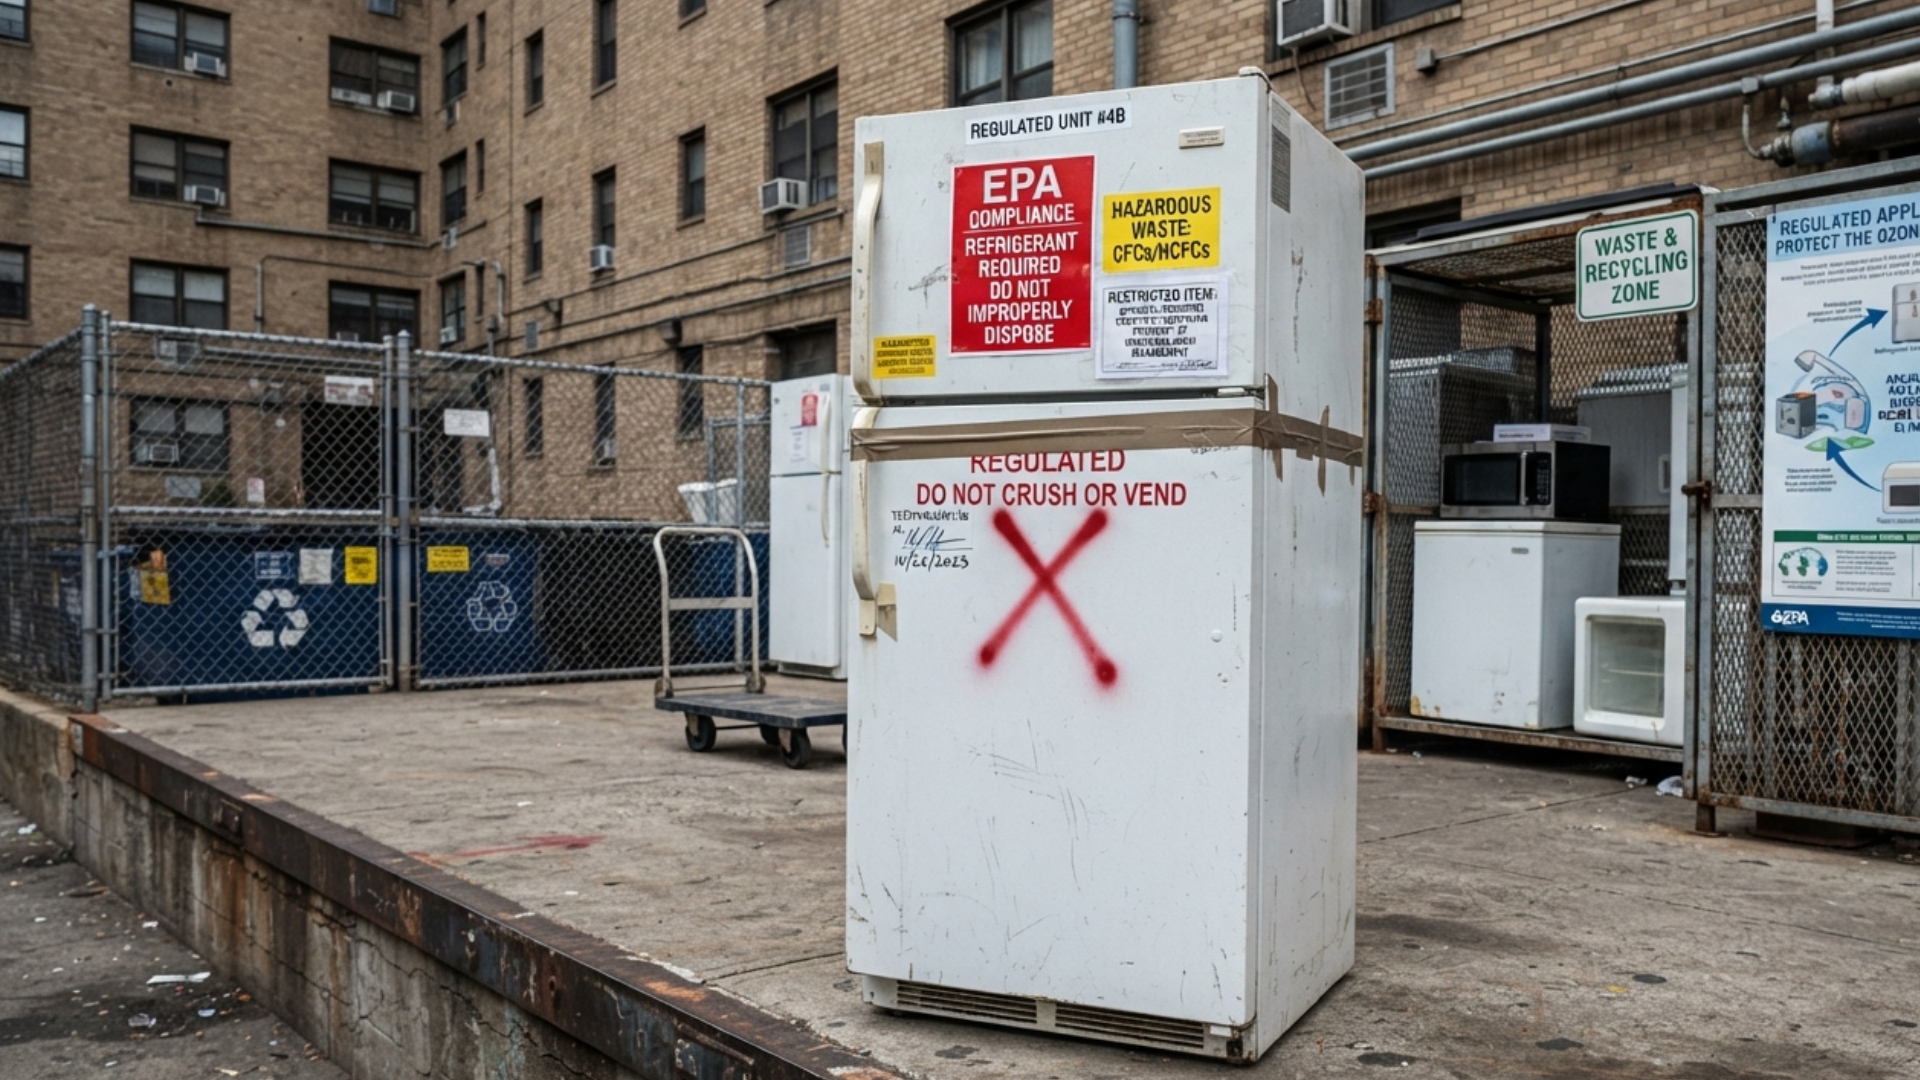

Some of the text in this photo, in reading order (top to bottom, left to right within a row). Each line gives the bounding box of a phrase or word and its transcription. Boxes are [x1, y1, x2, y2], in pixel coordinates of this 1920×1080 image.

[971, 107, 1126, 139] REGULATED UNIT #4B
[983, 164, 1062, 204] EPA
[1779, 209, 1872, 236] REGULATED
[965, 231, 1079, 257] REFRIGERANT
[1594, 227, 1678, 257] WASTE &
[1775, 234, 1840, 256] PROTECT
[1844, 230, 1873, 247] THE
[1585, 250, 1688, 284] RECYCLING
[990, 279, 1051, 300] DO NOT
[1611, 280, 1660, 304] ZONE
[968, 299, 1073, 323] IMPROPERLY
[916, 483, 1187, 506] DO NOT CRUSH OR VEND
